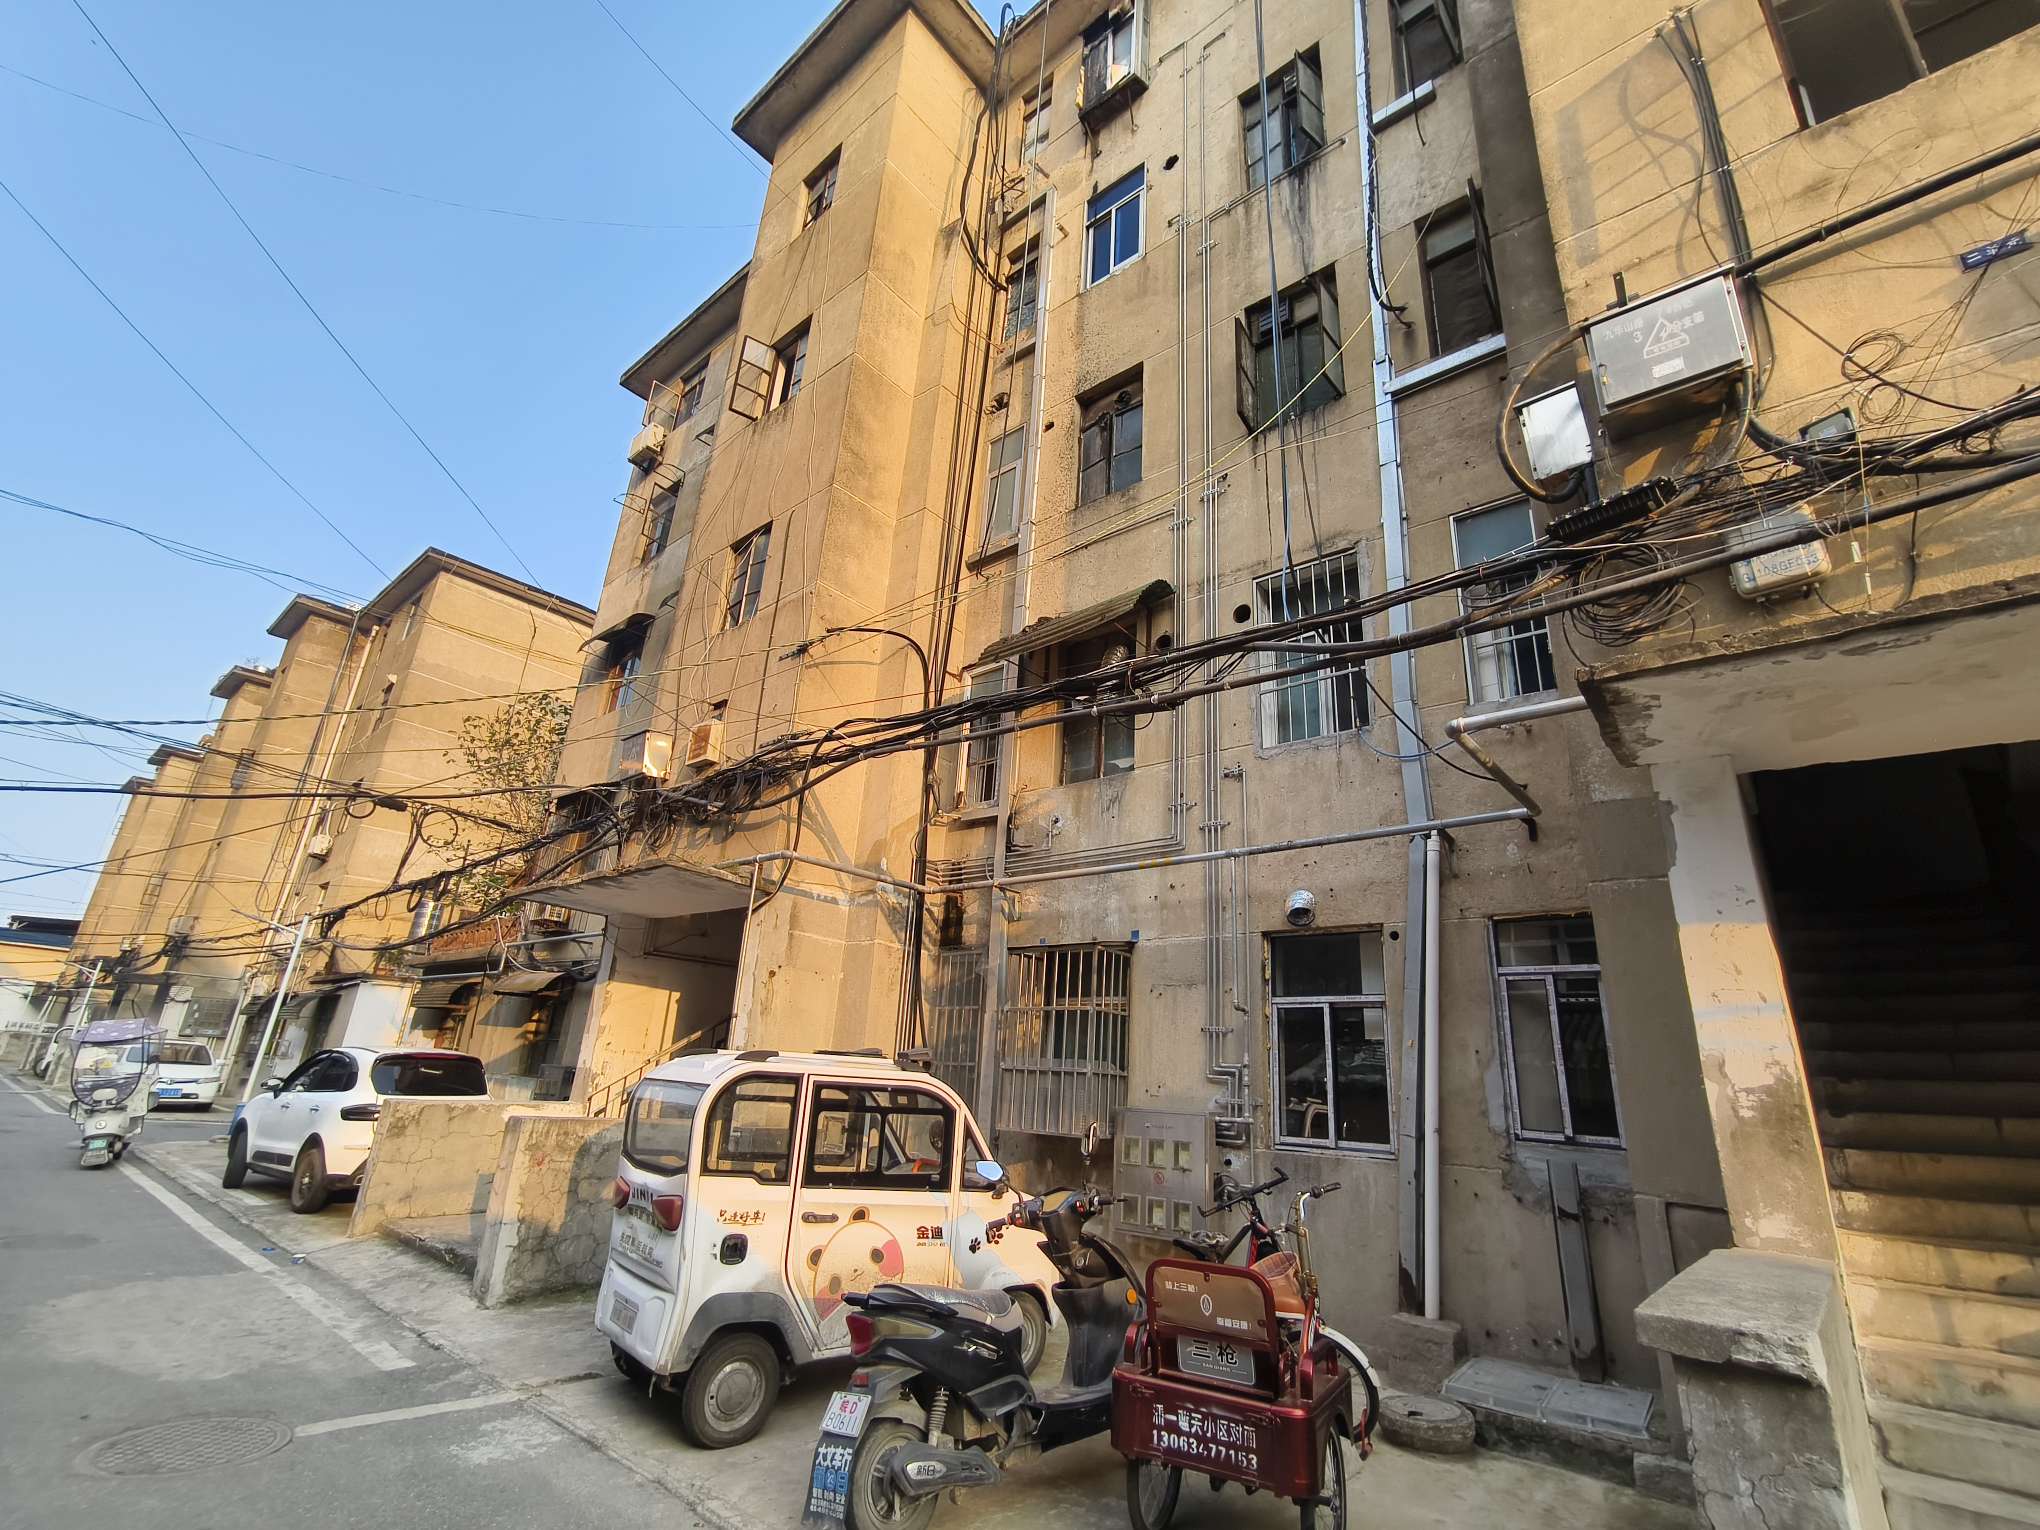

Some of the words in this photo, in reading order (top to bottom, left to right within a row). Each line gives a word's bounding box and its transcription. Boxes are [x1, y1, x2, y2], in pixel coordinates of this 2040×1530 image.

[916, 1226, 943, 1239] 金迪
[1192, 1339, 1238, 1367] 三枪
[1152, 1429, 1258, 1470] 13063477153
